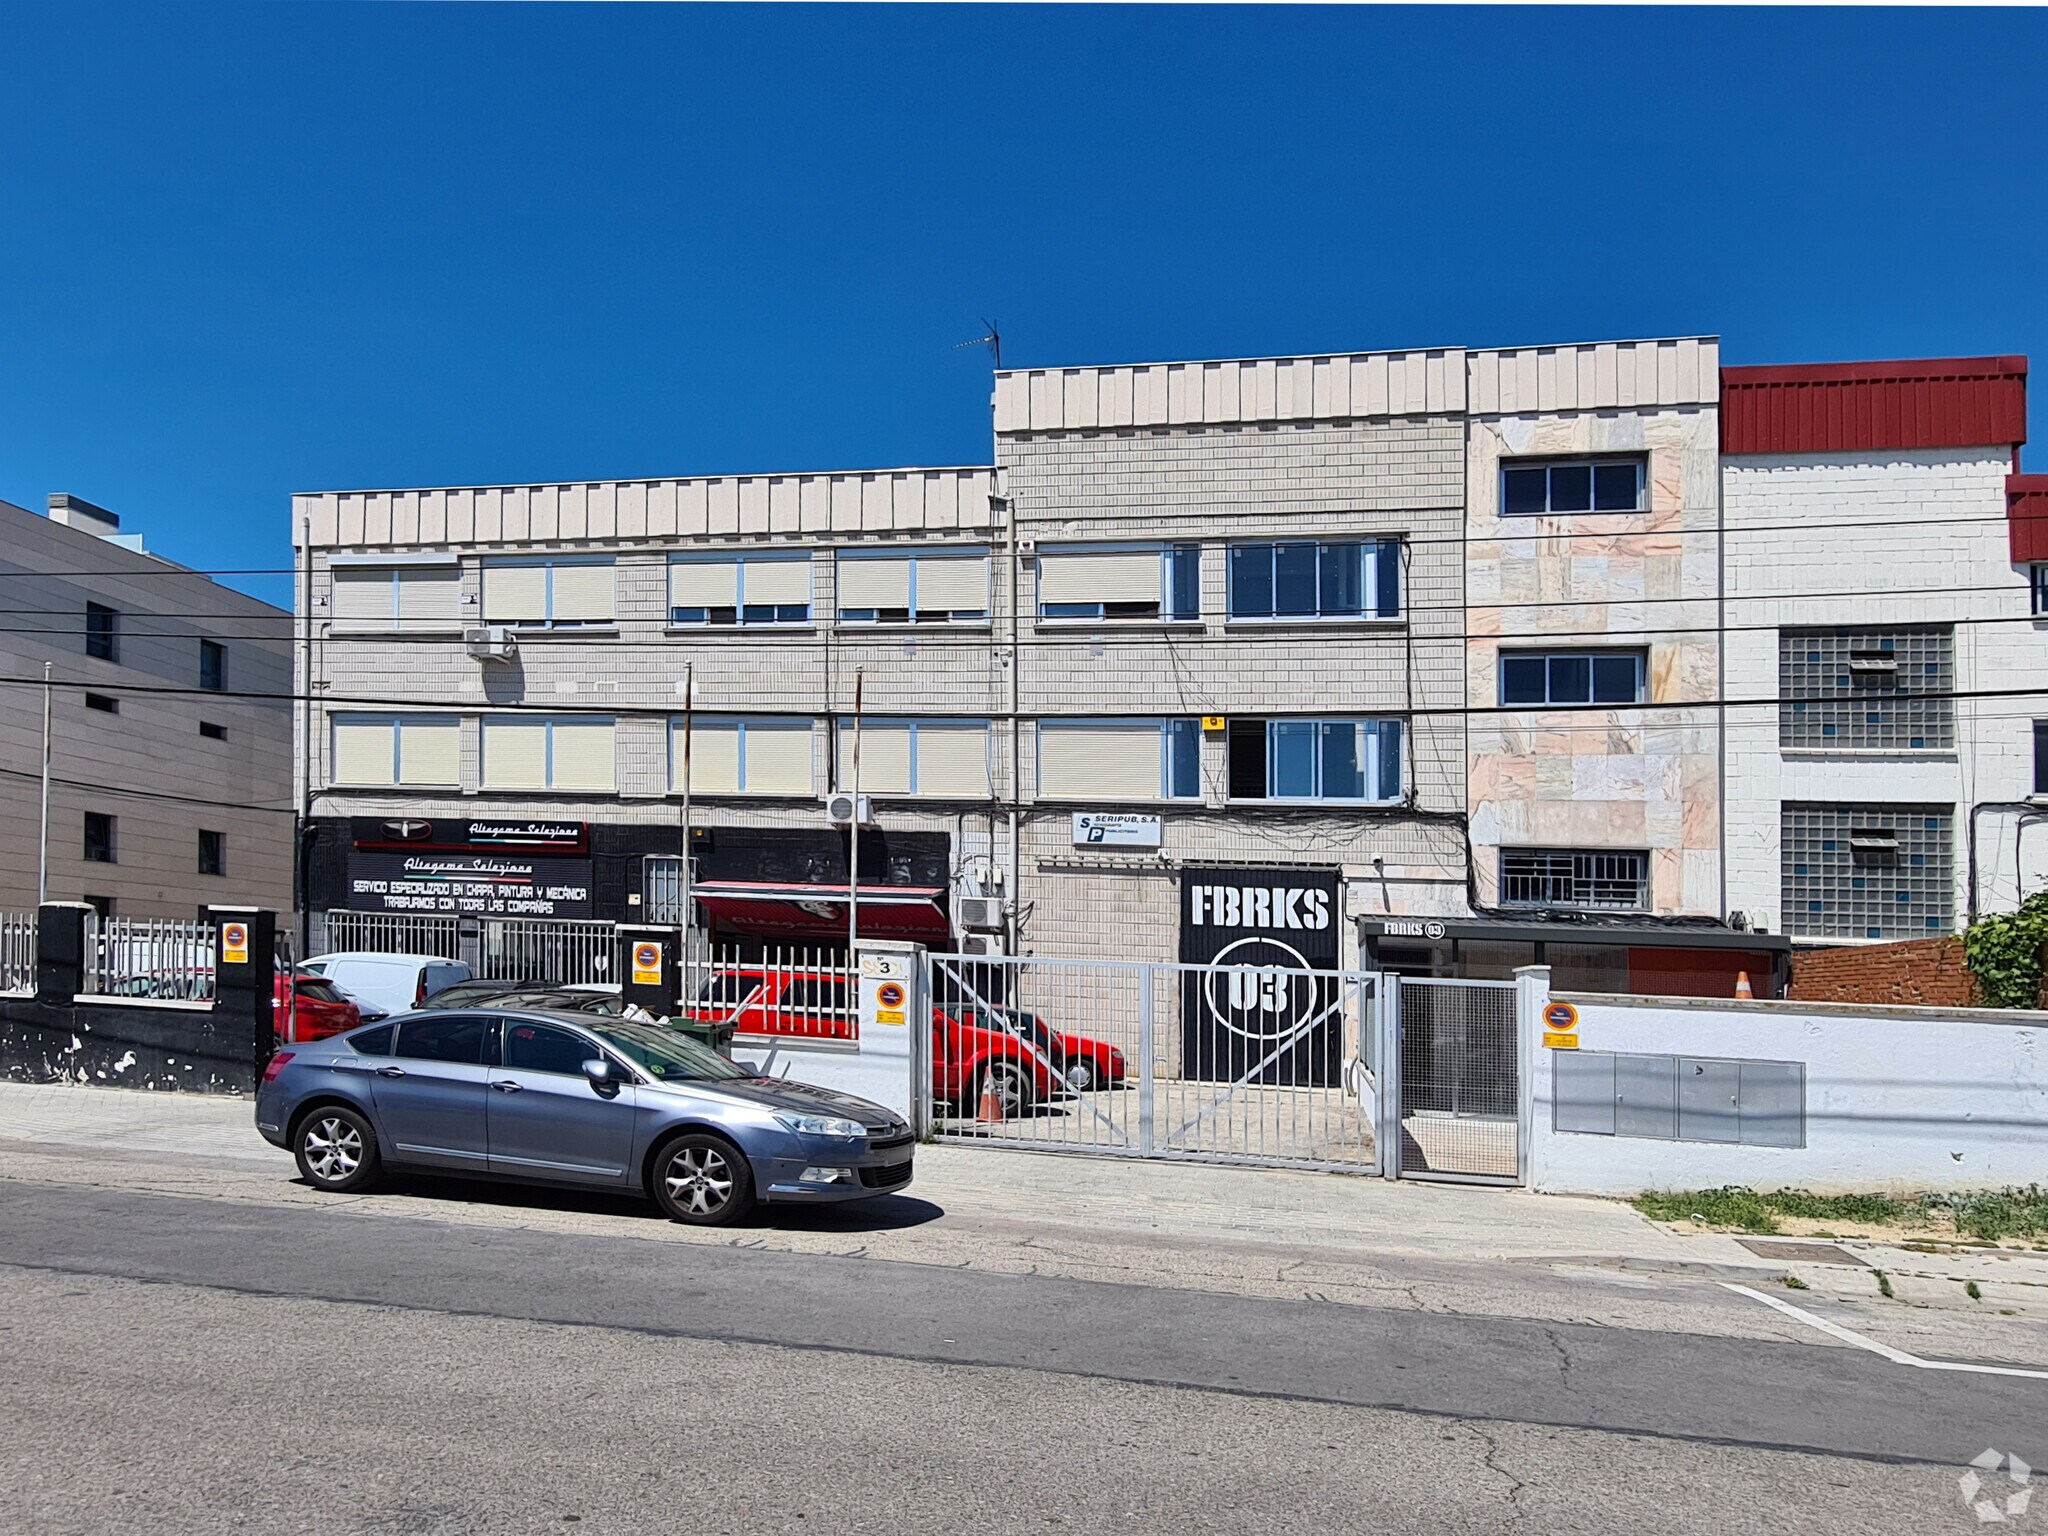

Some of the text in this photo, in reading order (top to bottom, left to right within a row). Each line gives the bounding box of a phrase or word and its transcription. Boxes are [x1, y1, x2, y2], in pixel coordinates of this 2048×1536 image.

[1080, 817, 1091, 829] S
[1095, 815, 1139, 824] SERIPUB,
[469, 823, 578, 838] Altagama Selezione
[1089, 828, 1103, 841] P
[403, 857, 533, 876] Altagama Selezione
[353, 880, 587, 901] SERVICIO ESPECIALIZADO EN CHAPA, PINTURA Y MECÁNICA
[383, 895, 436, 910] TRABAJAMOS
[438, 898, 455, 910] CON
[458, 898, 485, 911] TODAS
[488, 899, 504, 912] LAS
[1191, 885, 1330, 930] FBRKS
[850, 921, 949, 934] elezion
[1384, 922, 1442, 936] FBRKS 03
[880, 962, 890, 974] 3
[1229, 963, 1288, 1013] 03
